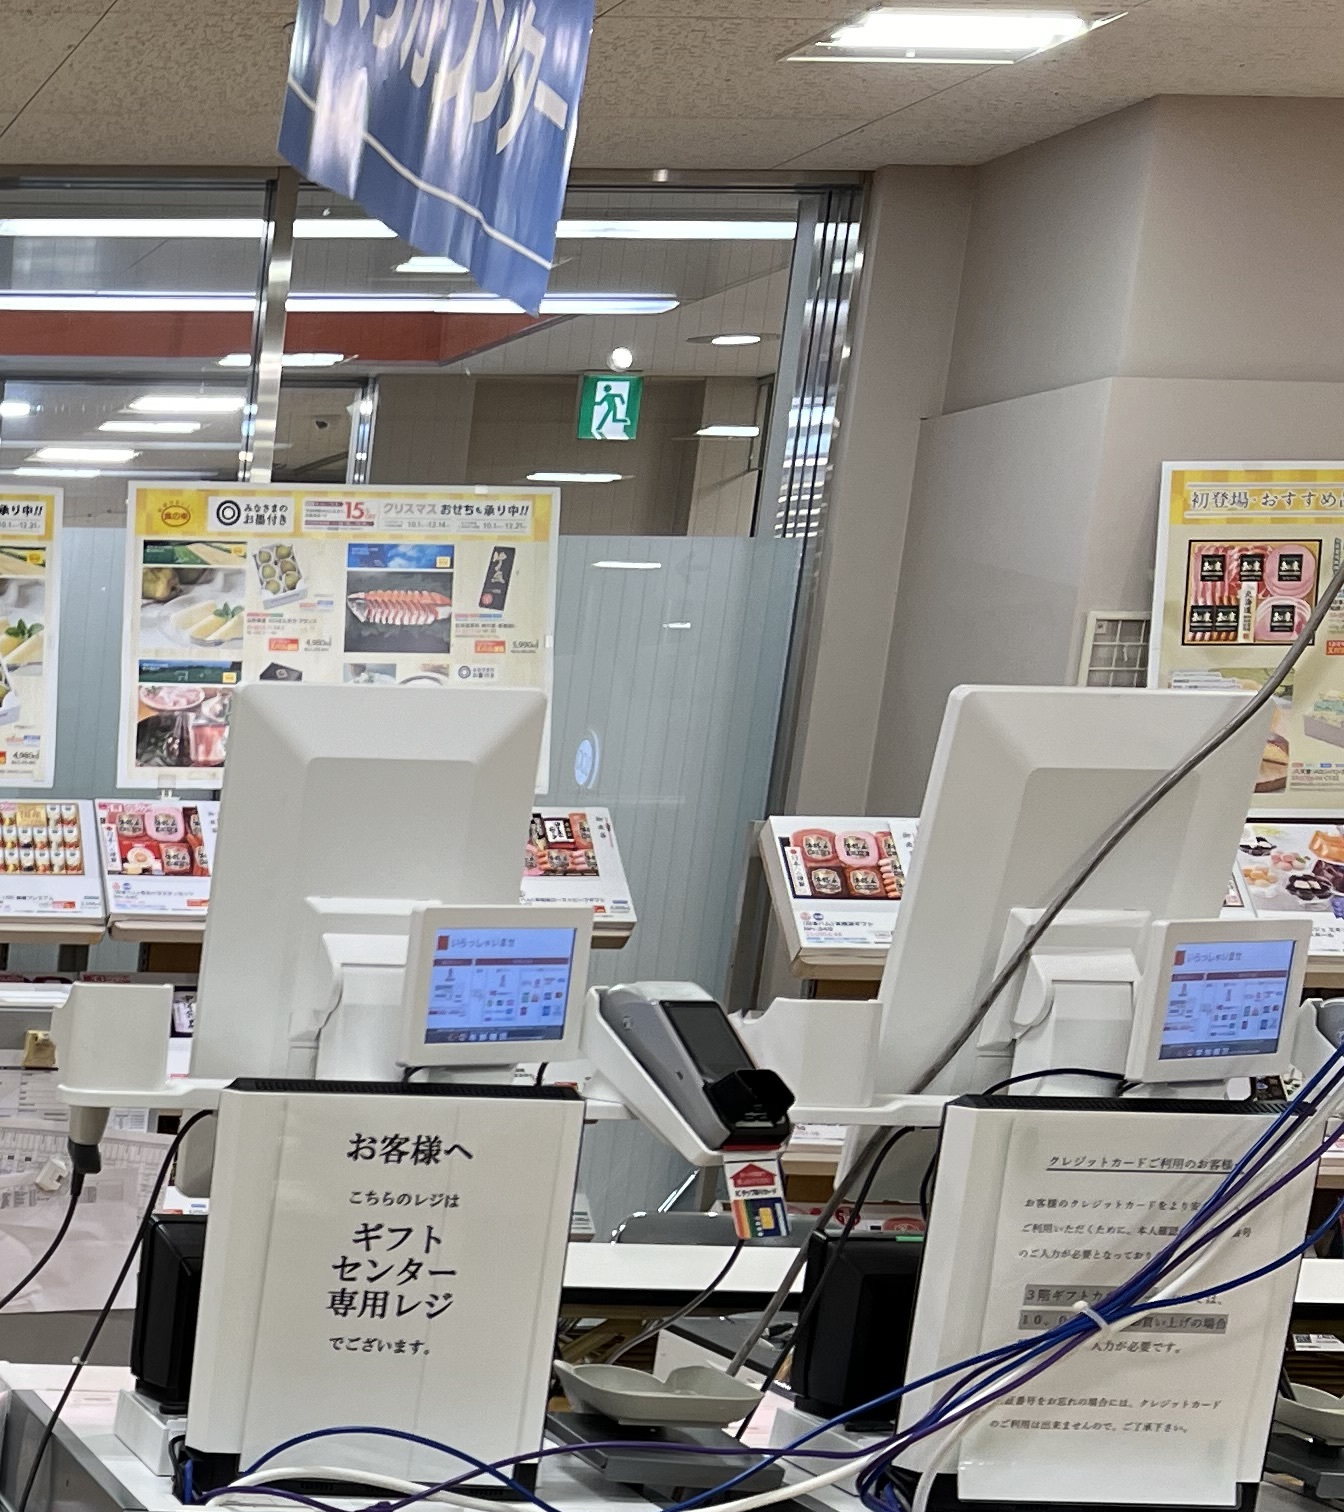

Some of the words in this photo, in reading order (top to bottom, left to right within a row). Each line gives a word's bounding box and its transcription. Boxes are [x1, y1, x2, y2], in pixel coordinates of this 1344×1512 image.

[244, 503, 289, 513] みなさまの
[384, 502, 437, 515] クリスマス
[1191, 490, 1344, 509] 初登場・おすすめ
[344, 501, 366, 519] 15
[243, 513, 288, 526] お墨付き
[346, 1133, 474, 1166] お客様へ
[1048, 1156, 1238, 1171] クレジットカードご利用のお客様
[348, 1190, 460, 1208] こちらのレジは
[352, 1223, 443, 1254] ギフト
[331, 1256, 457, 1286] センター
[325, 1287, 454, 1319] 専用レジ
[328, 1337, 431, 1356] でございます。
[1091, 1341, 1180, 1354] 入力が必要です。
